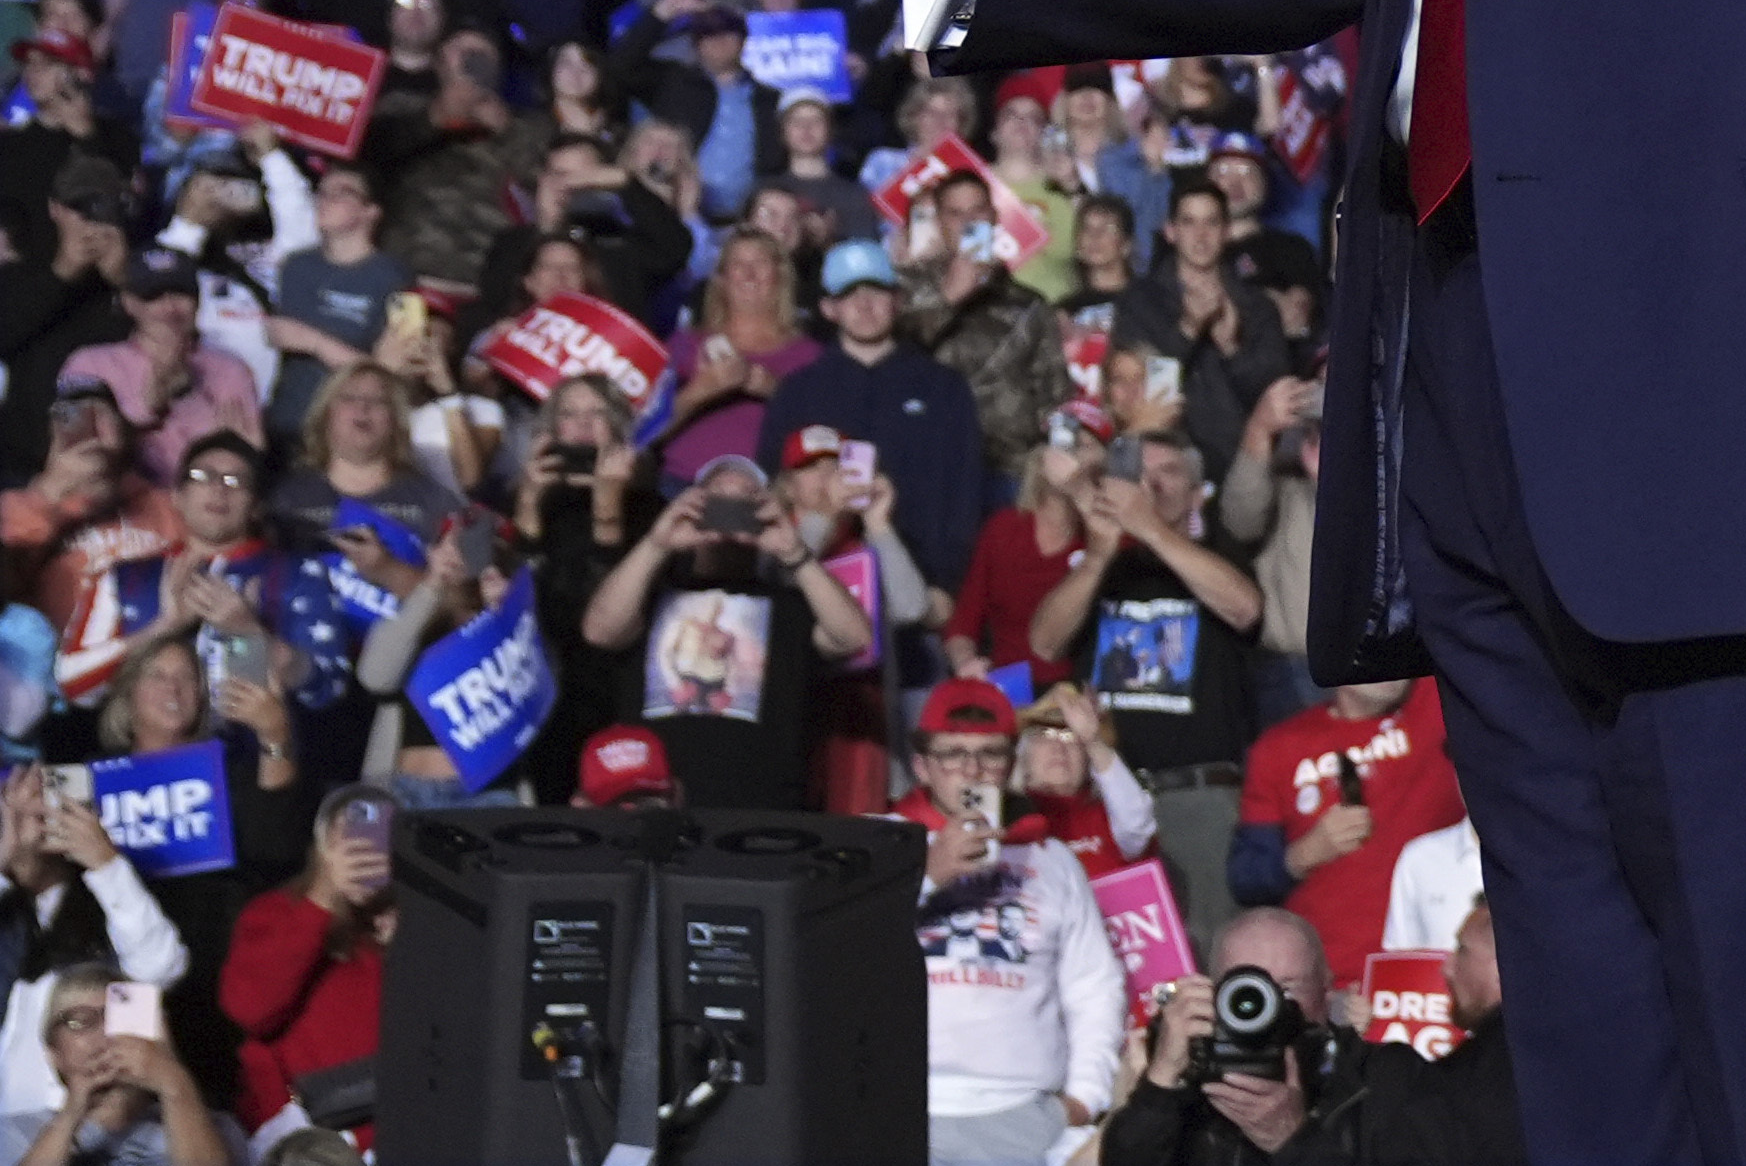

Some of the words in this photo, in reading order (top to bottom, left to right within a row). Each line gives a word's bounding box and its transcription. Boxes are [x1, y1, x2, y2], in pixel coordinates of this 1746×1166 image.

[213, 64, 278, 105] WILL
[221, 33, 367, 99] TRUMP
[507, 330, 562, 368] WILL
[523, 308, 649, 397] TRUMP
[173, 811, 214, 842] IT
[1373, 991, 1452, 1023] DRE
